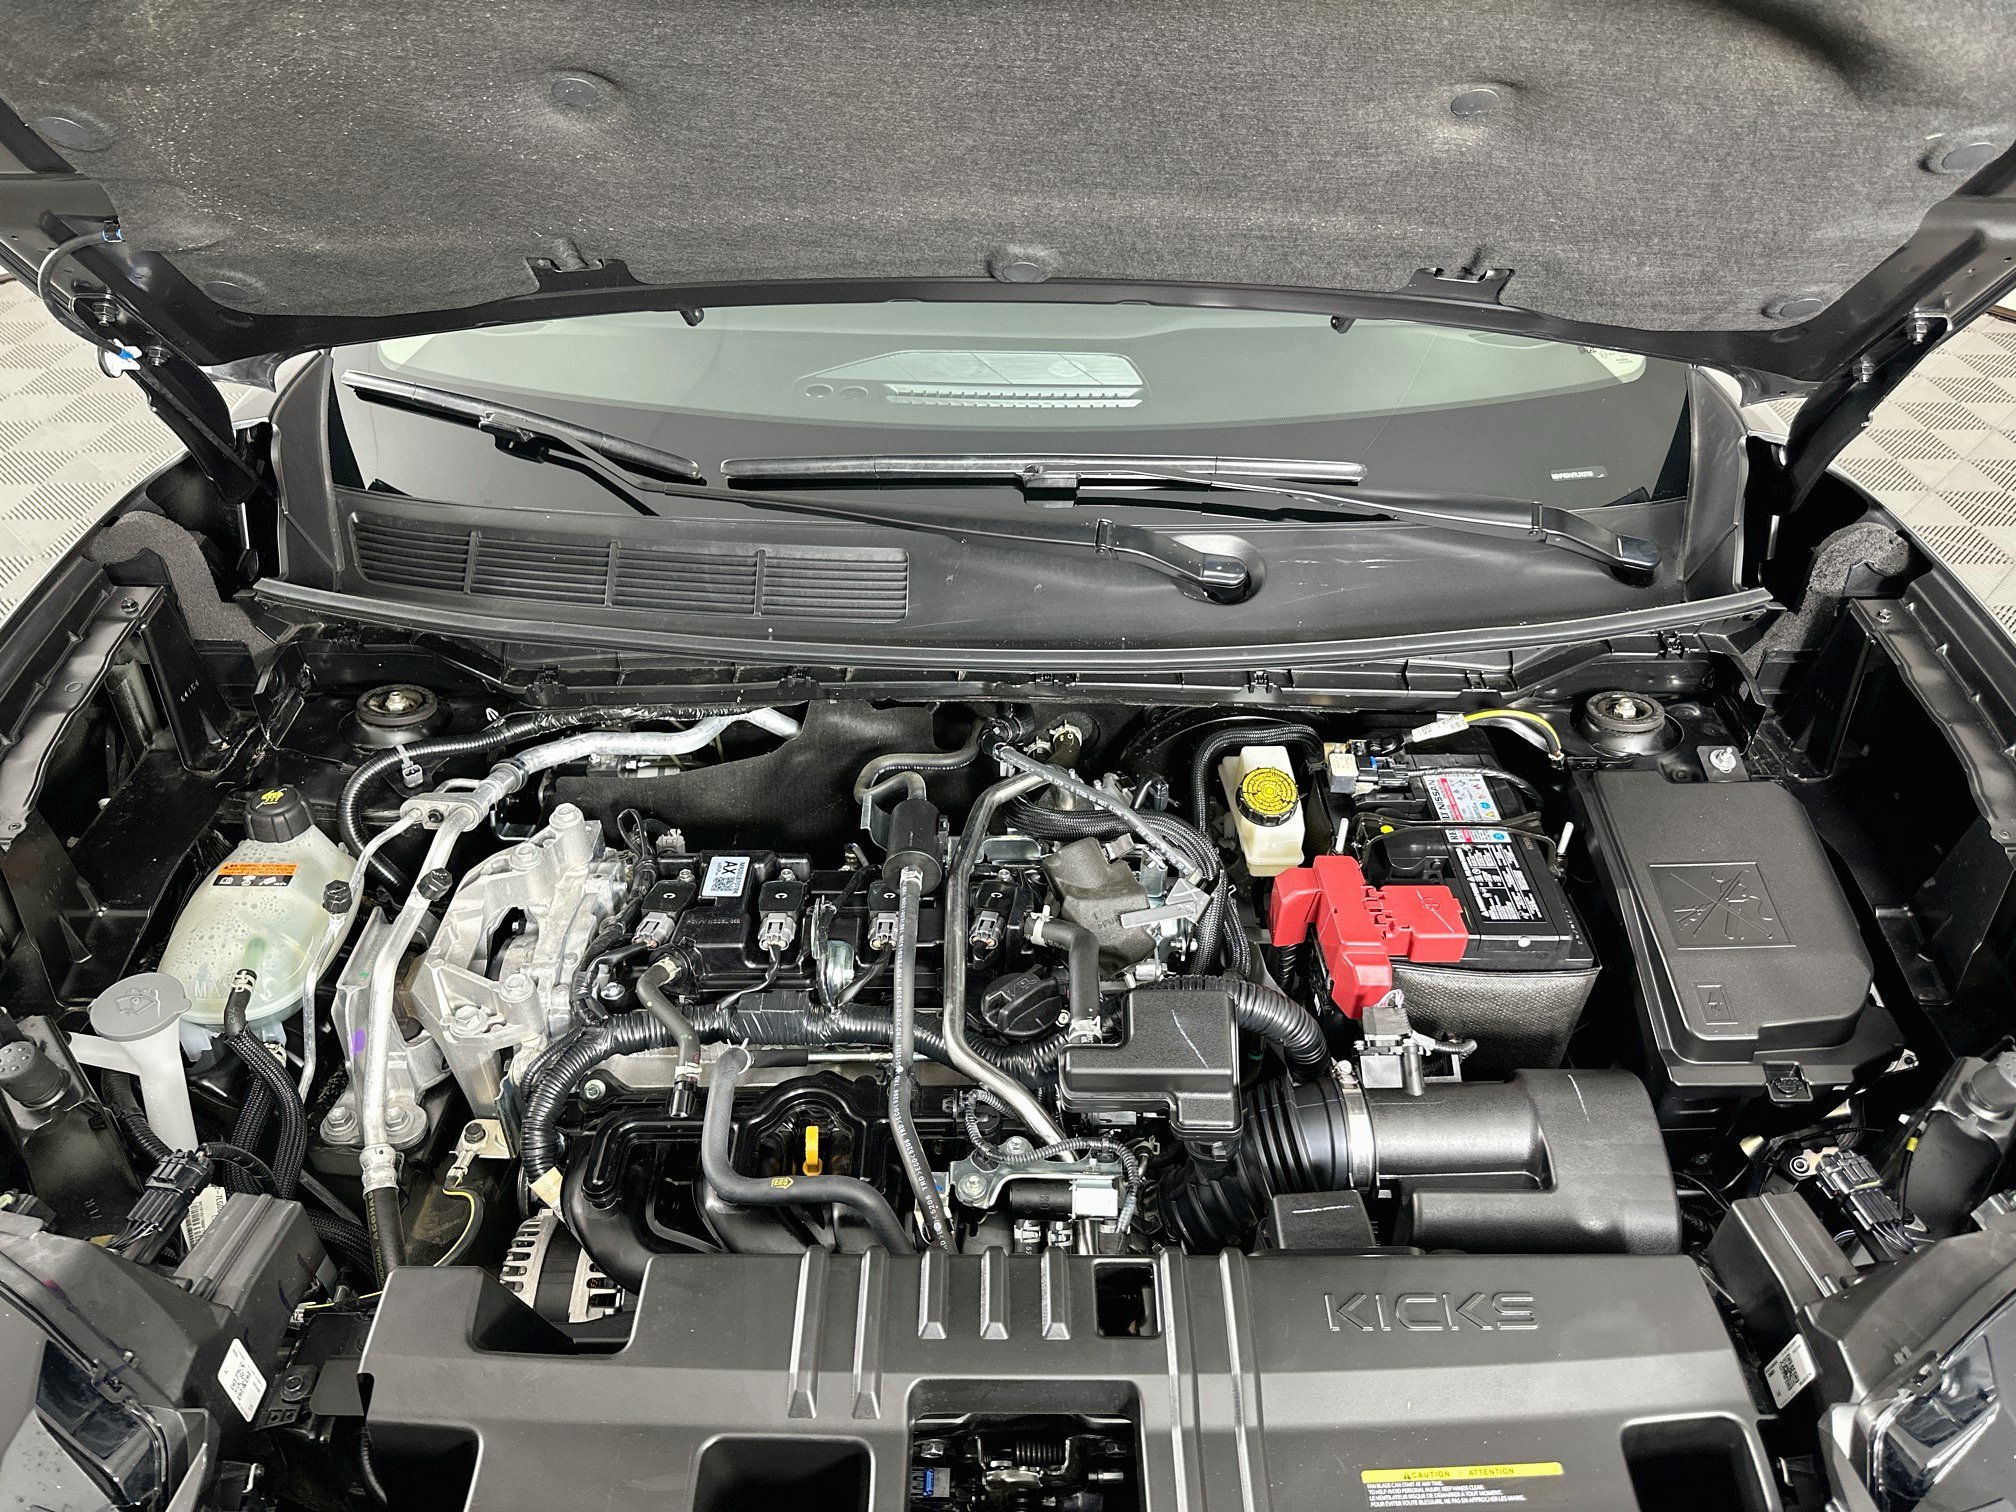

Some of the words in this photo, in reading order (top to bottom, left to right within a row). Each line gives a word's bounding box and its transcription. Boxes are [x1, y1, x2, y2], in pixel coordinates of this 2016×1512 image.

[1428, 779, 1446, 811] NISSAN
[721, 861, 738, 874] AX
[1324, 1291, 1540, 1332] KICKS
[1411, 1471, 1450, 1480] CAUTION
[1468, 1468, 1515, 1476] ATTENTION
